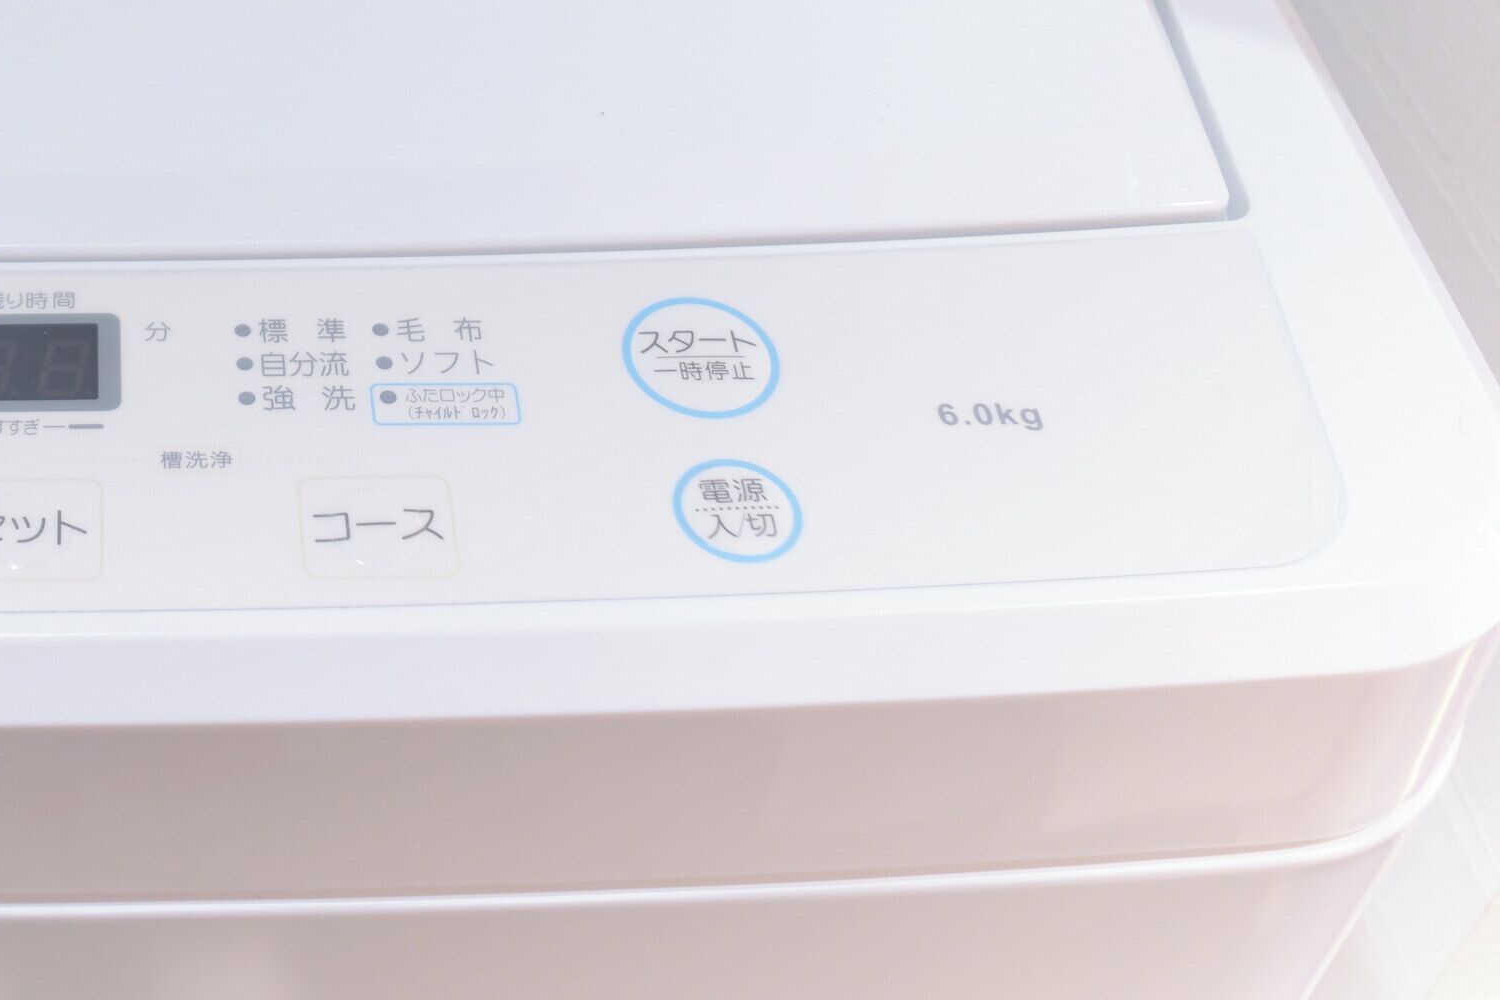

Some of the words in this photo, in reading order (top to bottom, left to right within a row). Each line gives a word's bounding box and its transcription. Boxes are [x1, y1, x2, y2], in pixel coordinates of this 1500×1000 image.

[144, 321, 171, 342] 分
[638, 329, 757, 353] スタート
[260, 351, 350, 377] 自分流
[400, 349, 493, 375] ソフト
[654, 360, 755, 381] 一時停止
[405, 386, 505, 403] ふたロック中
[937, 403, 1043, 431] 6.0kg
[160, 450, 233, 469] 槽洗浄
[698, 478, 769, 503] 電源
[313, 508, 444, 543] コース
[707, 512, 778, 540] 入/切
